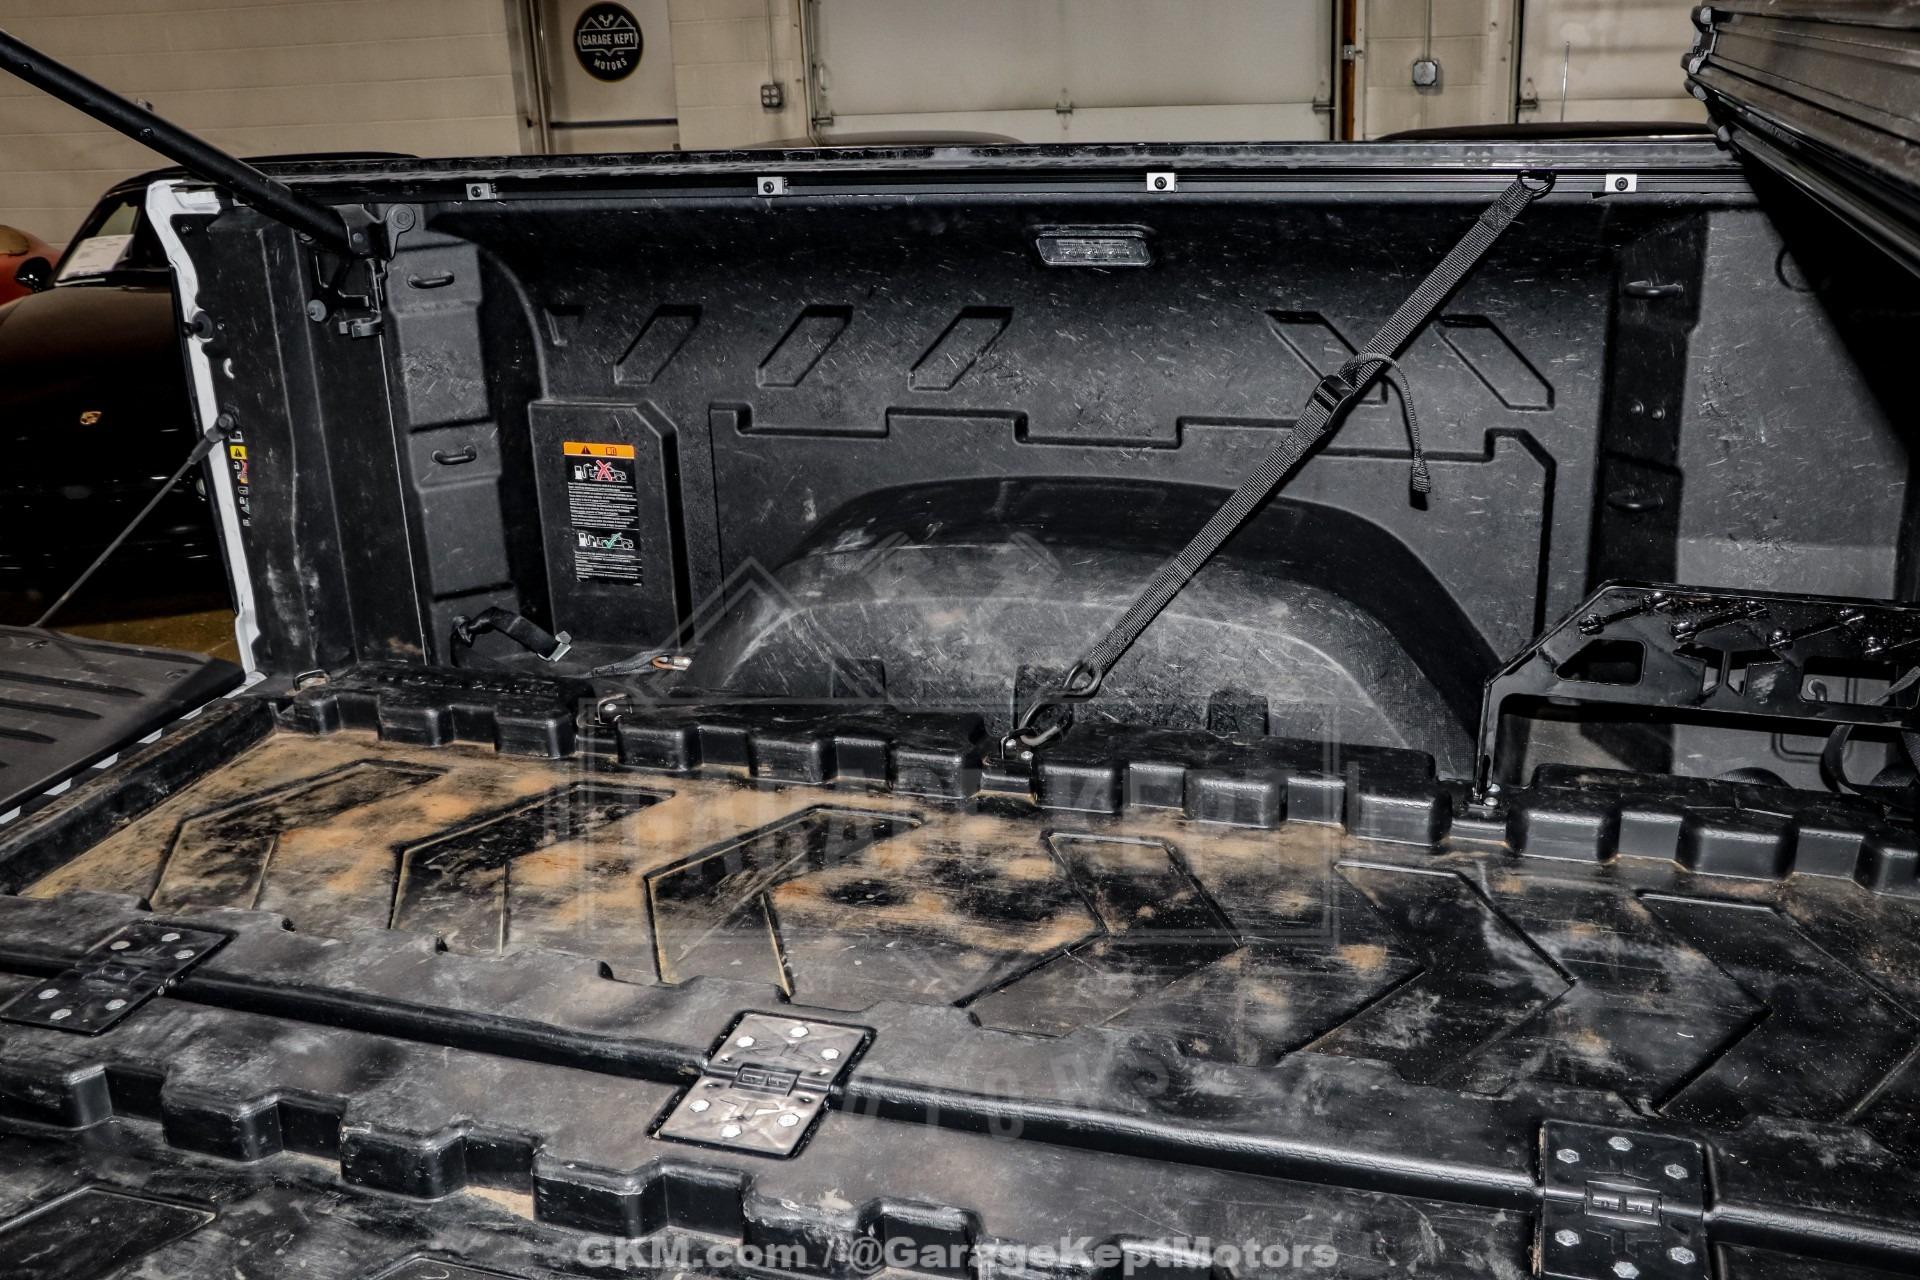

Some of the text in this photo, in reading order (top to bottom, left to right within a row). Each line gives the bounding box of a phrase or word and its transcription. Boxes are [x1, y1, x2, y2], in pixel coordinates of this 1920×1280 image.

[582, 33, 634, 46] GARAGE KEPT
[594, 58, 628, 70] MOTORS
